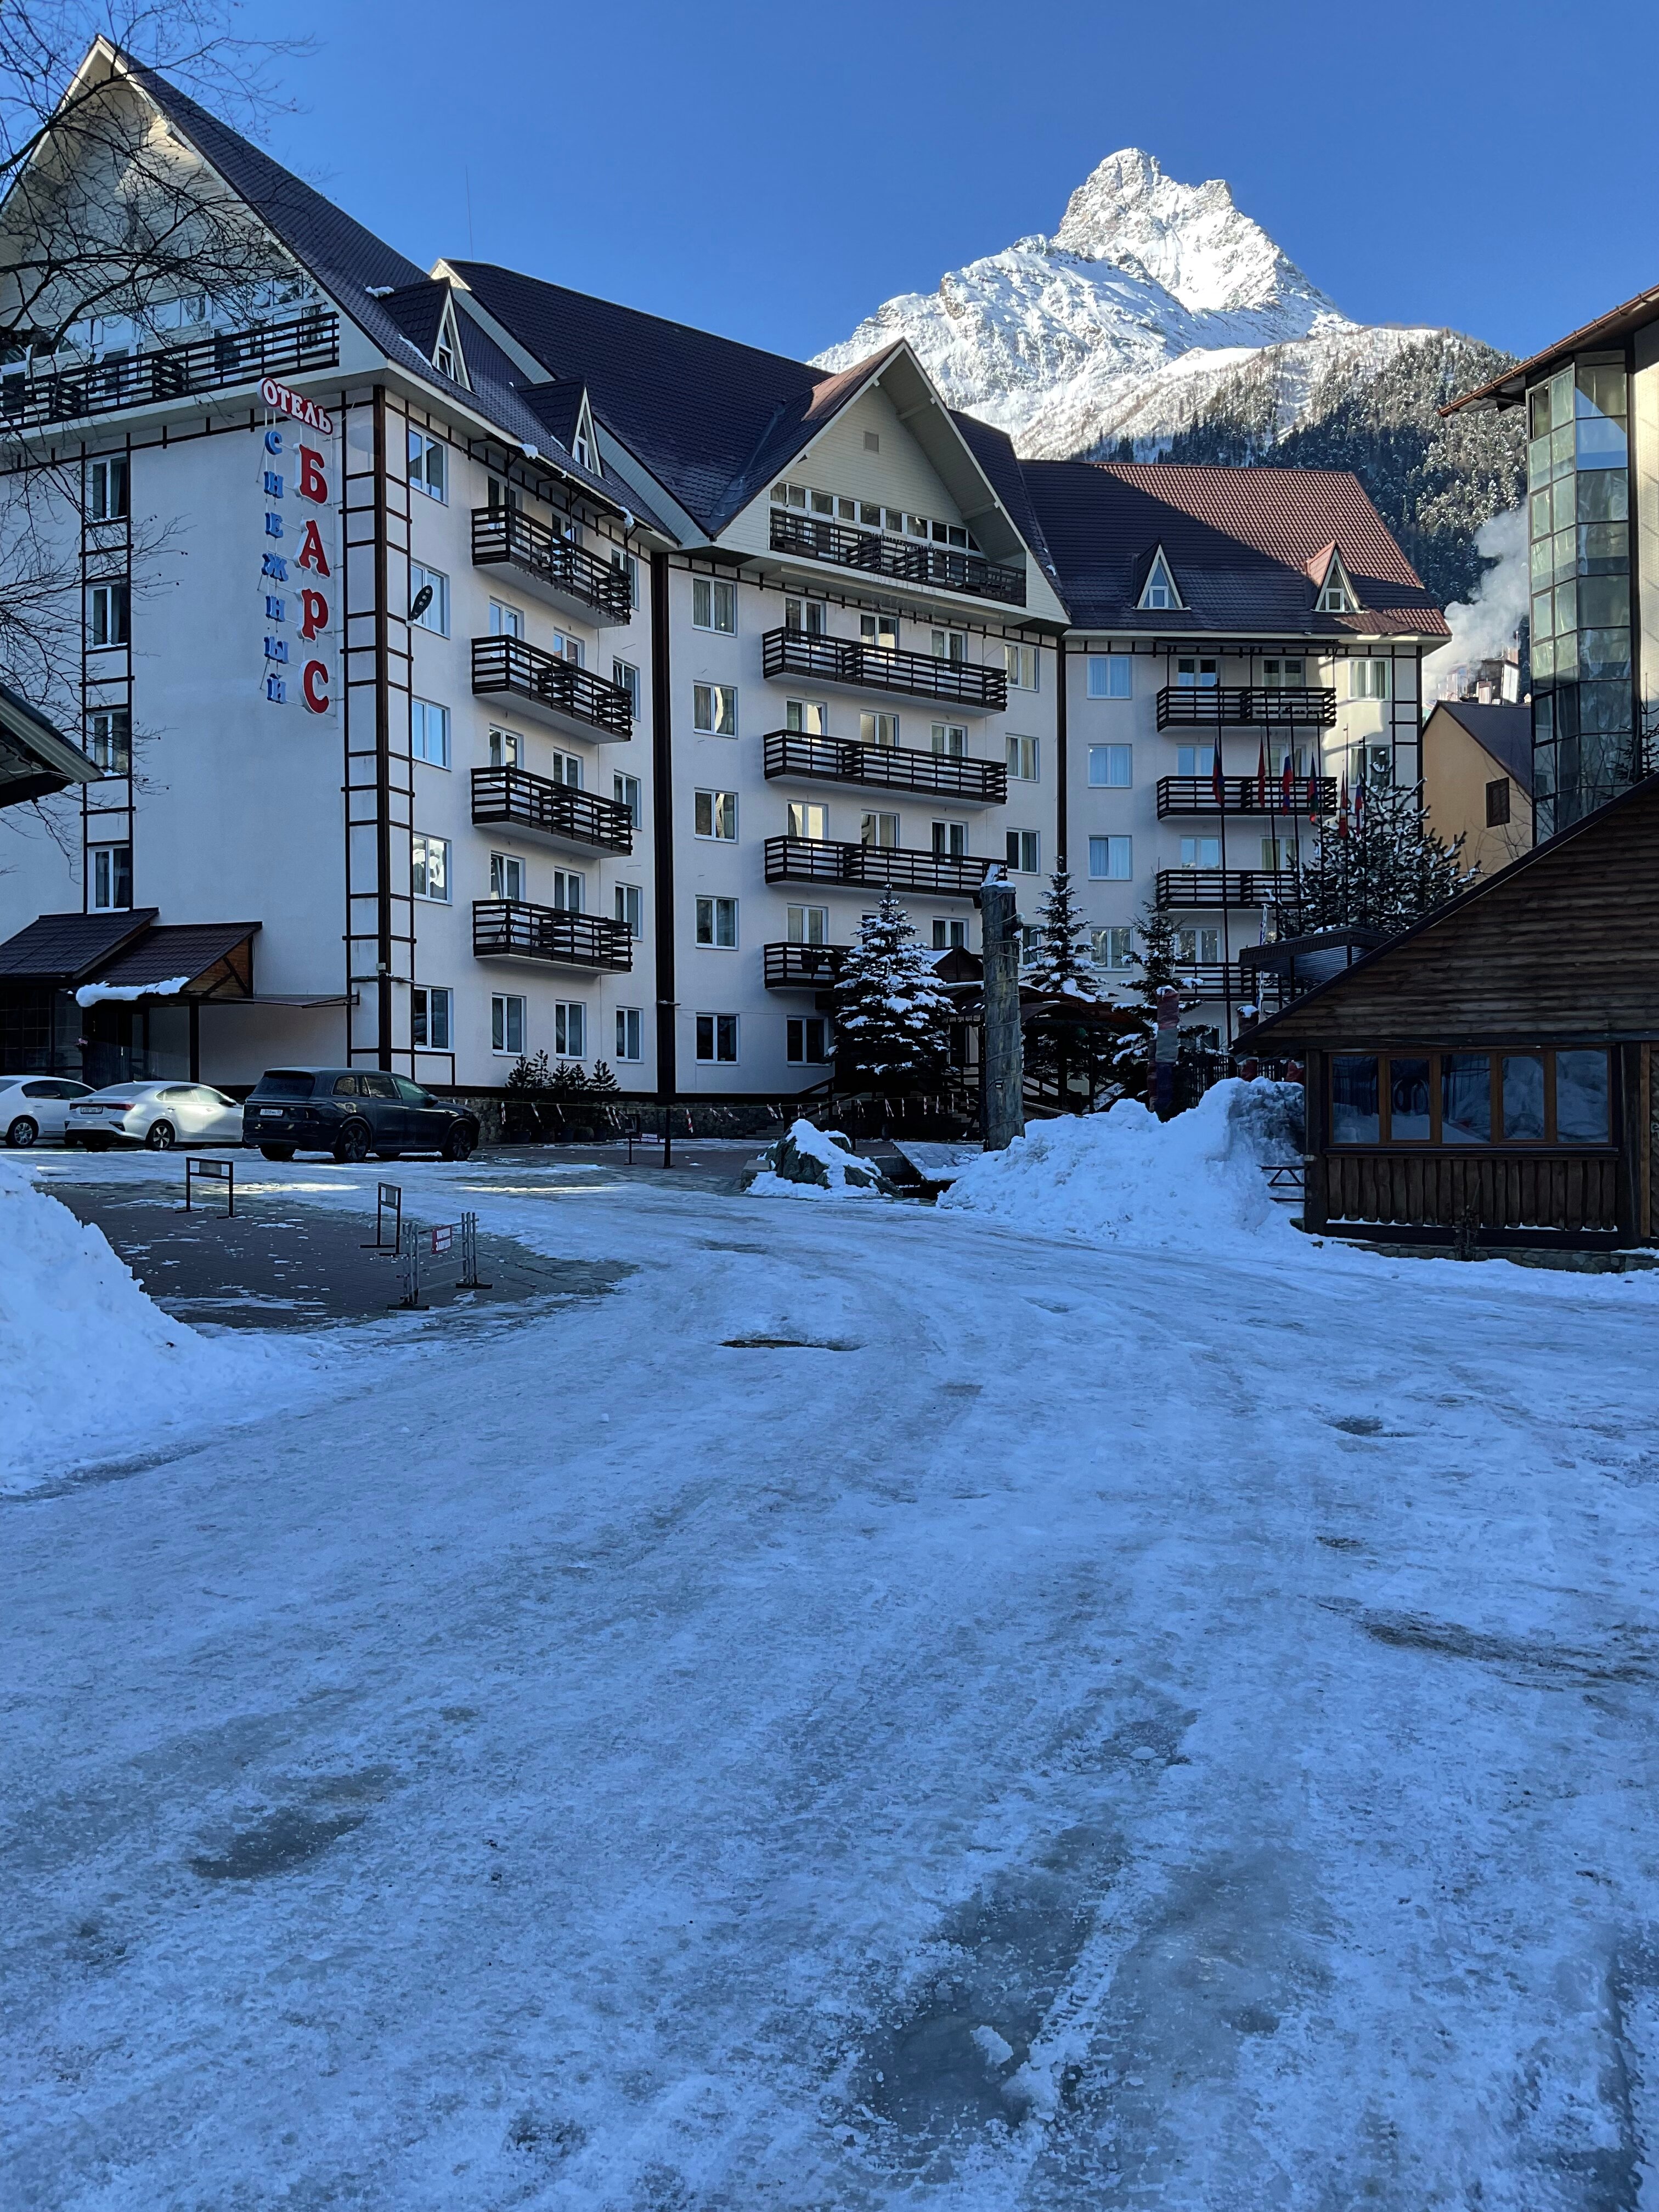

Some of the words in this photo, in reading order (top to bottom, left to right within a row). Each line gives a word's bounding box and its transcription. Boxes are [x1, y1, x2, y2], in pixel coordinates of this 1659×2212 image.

[263, 380, 331, 433] ОТЕЛЬ
[263, 431, 289, 704] СНЕЖНЫЙ
[297, 443, 330, 714] БАРС
